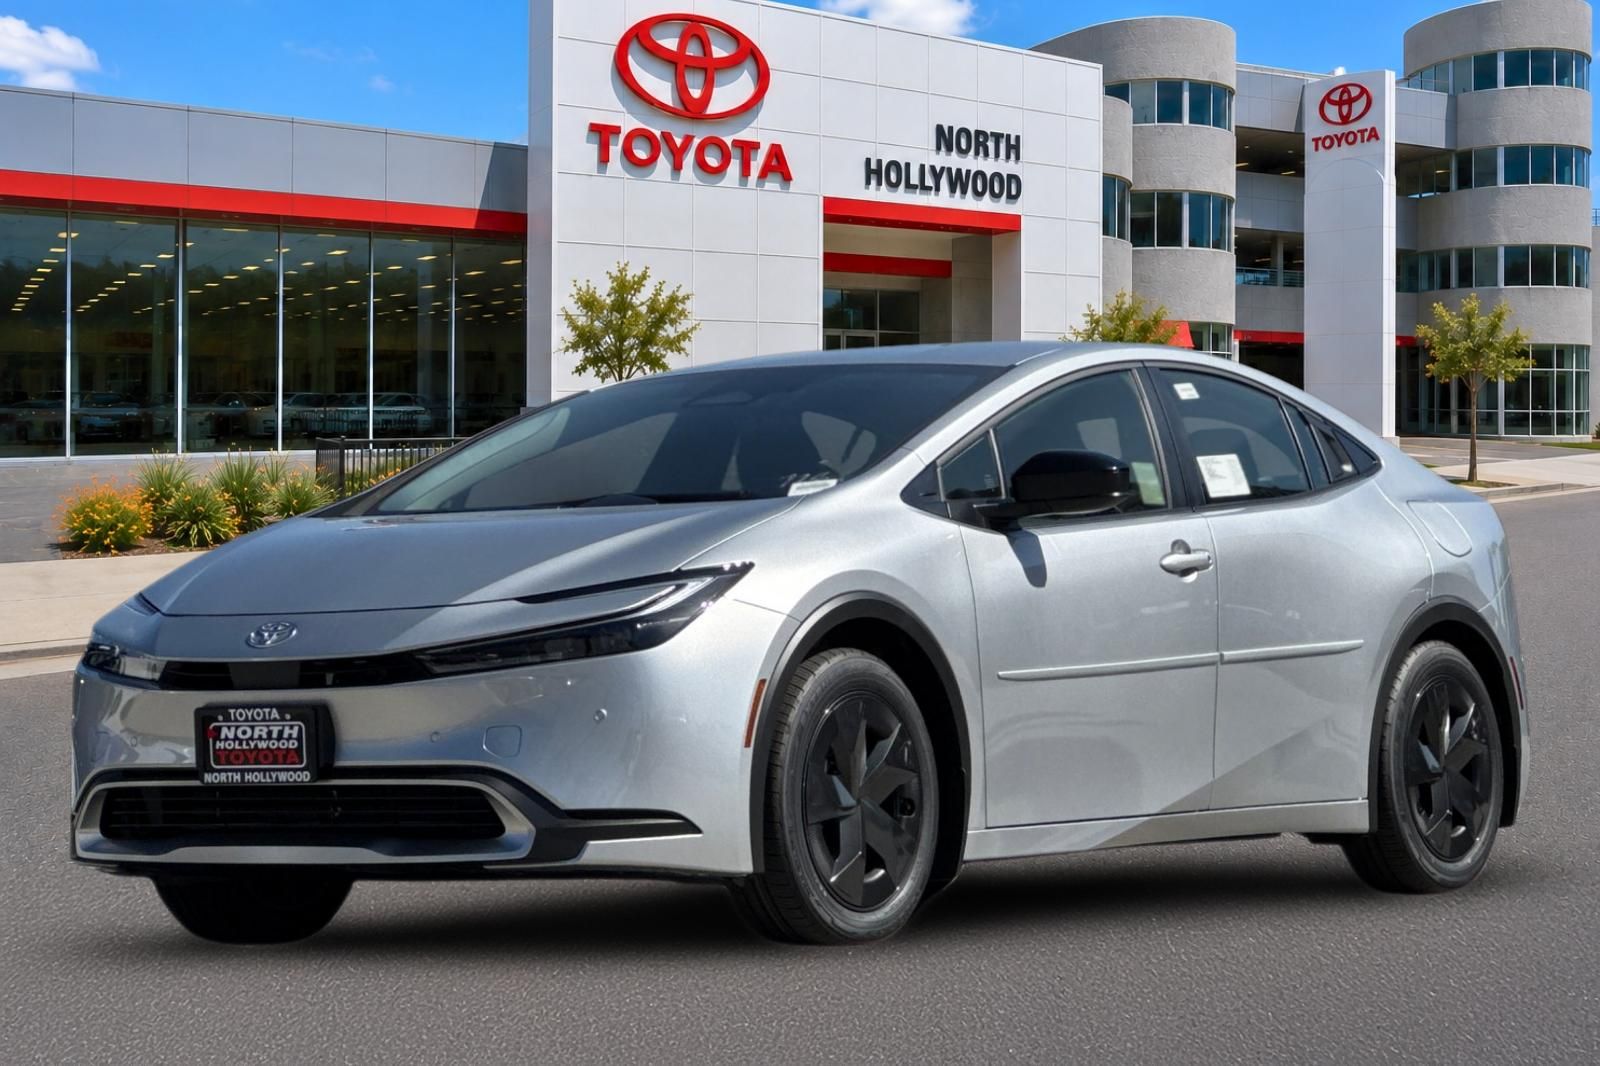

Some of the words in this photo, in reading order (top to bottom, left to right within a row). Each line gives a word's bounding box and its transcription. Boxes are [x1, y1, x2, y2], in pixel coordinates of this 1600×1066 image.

[935, 123, 1022, 162] NORTH
[1311, 126, 1380, 152] TOYOTA
[589, 122, 793, 183] TOYOTA
[865, 157, 1022, 201] HOLLYWOOD
[228, 708, 280, 720] TOYOTA
[220, 726, 299, 739] NORTH
[215, 740, 298, 750] HOLLYWOOD
[216, 750, 300, 764] TOYOTA
[204, 772, 241, 783] NORTH
[244, 771, 311, 783] HOLLYWOOD
